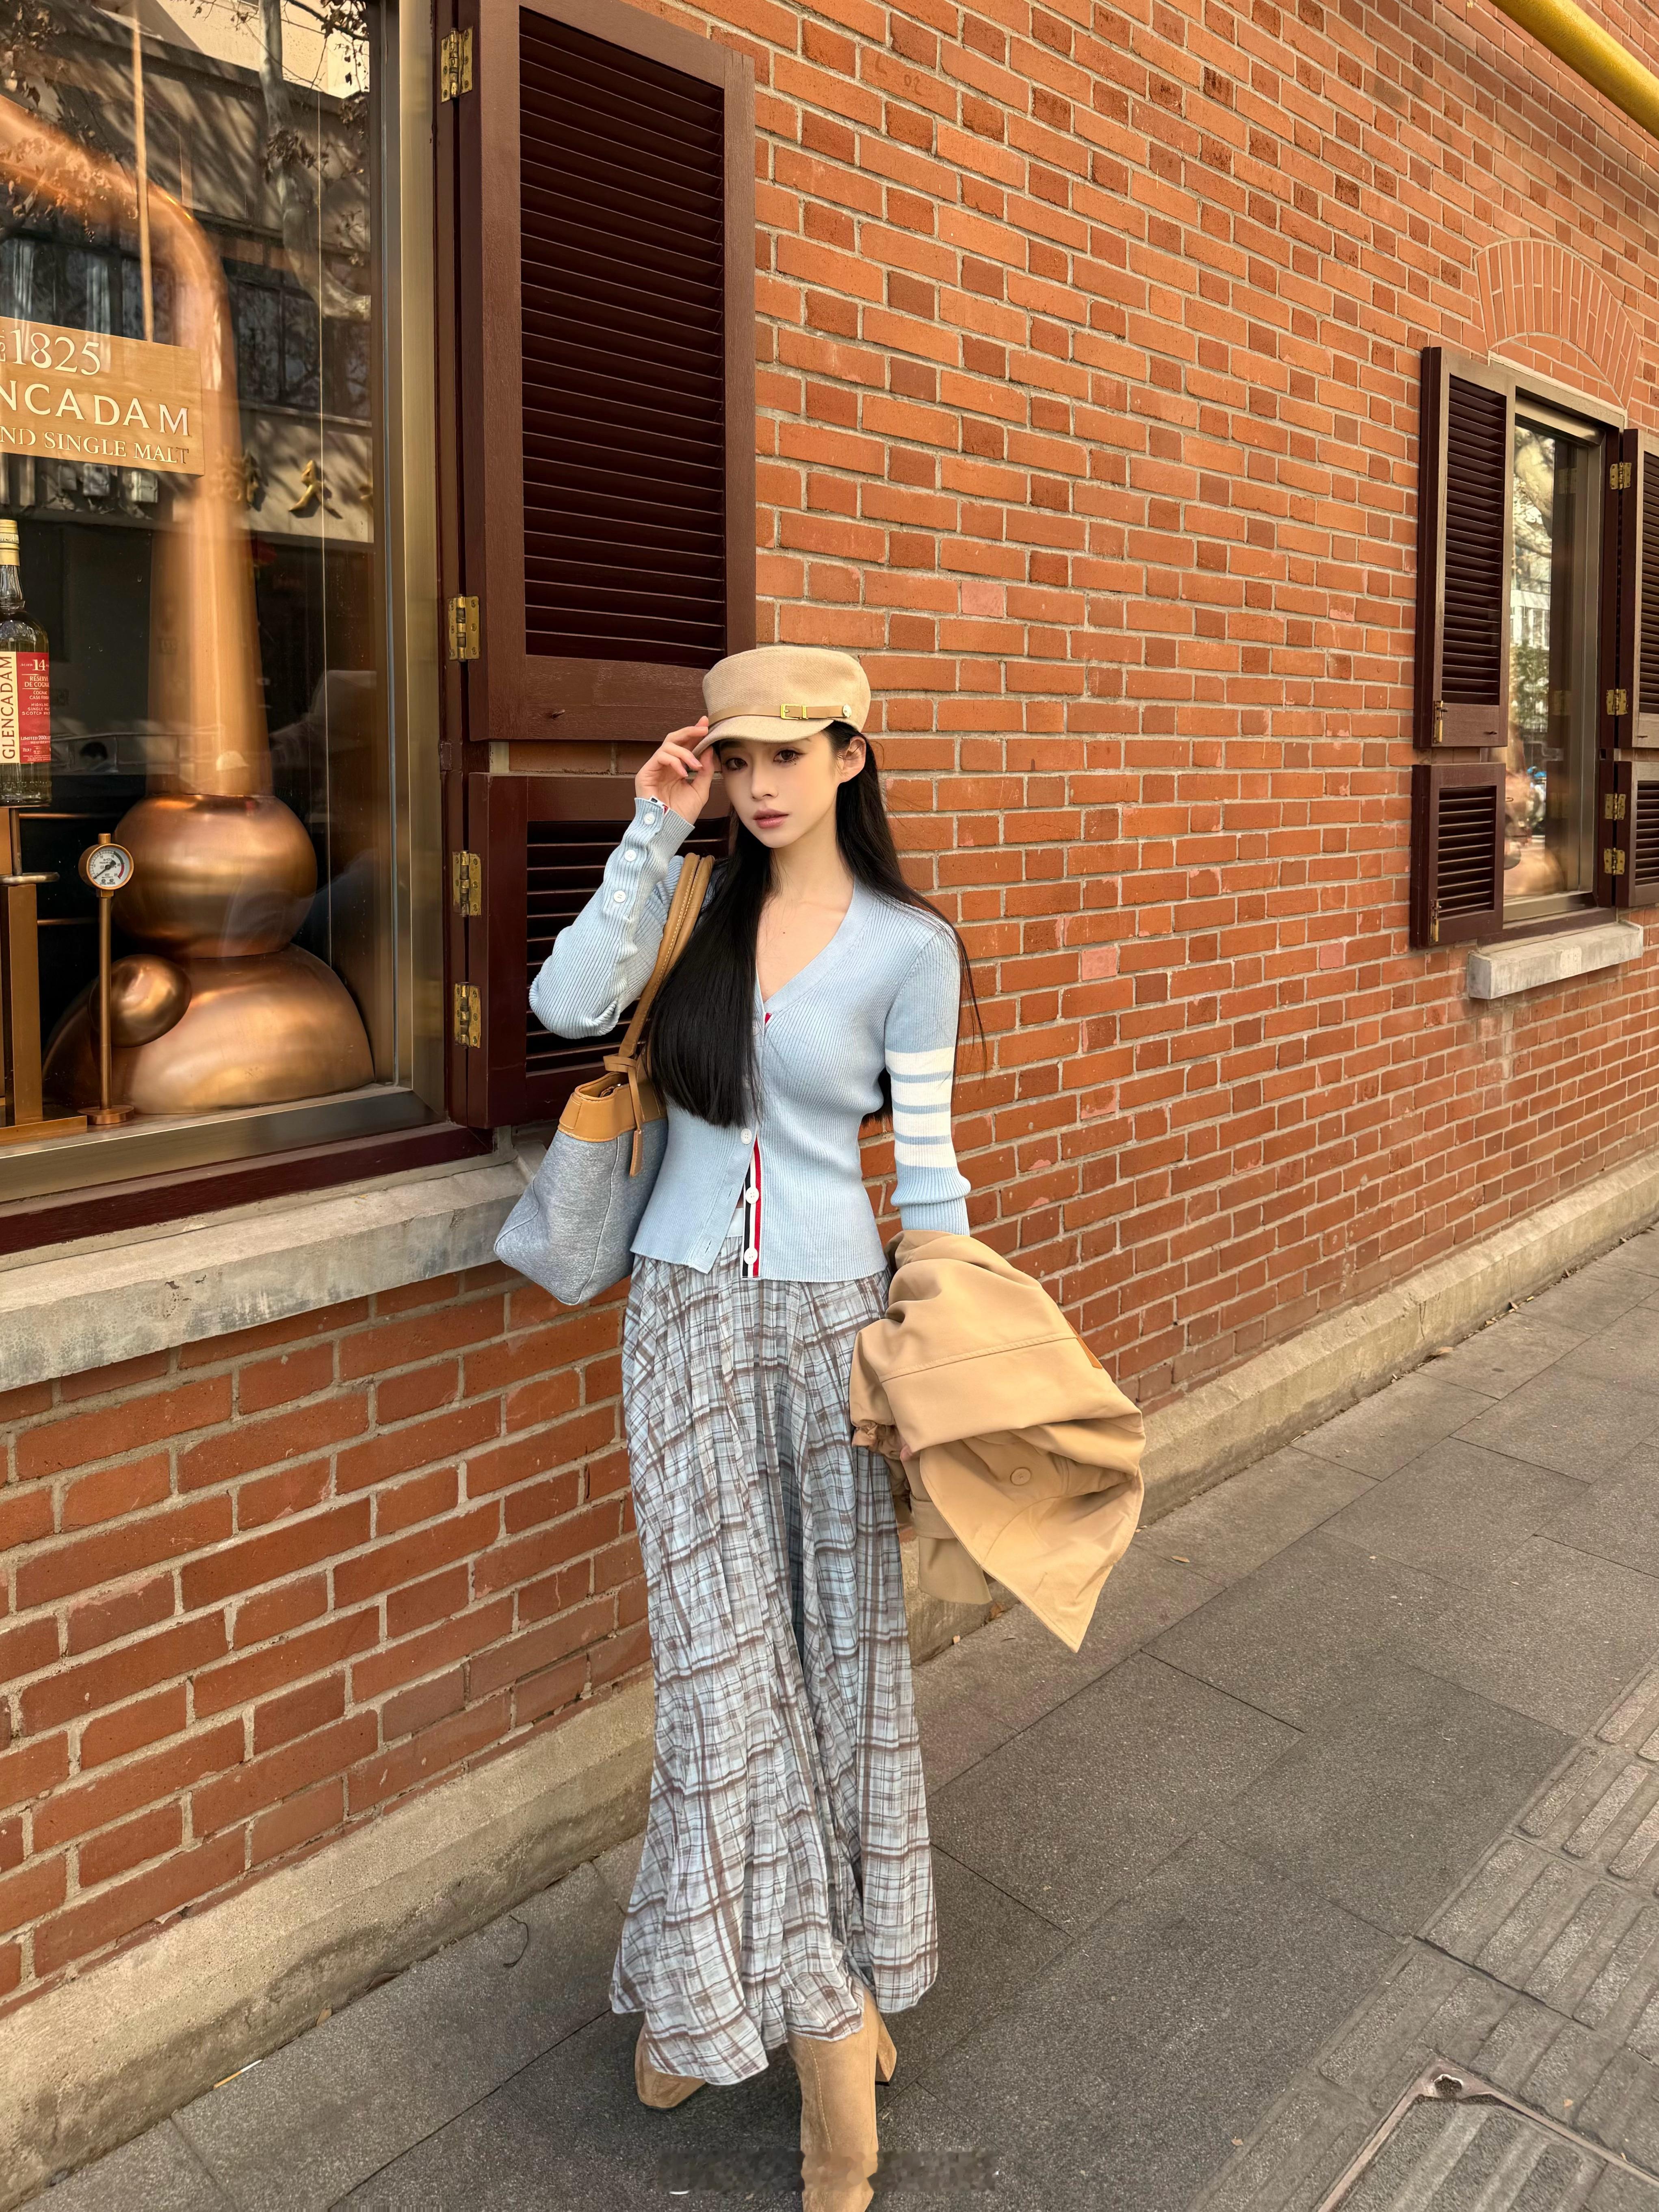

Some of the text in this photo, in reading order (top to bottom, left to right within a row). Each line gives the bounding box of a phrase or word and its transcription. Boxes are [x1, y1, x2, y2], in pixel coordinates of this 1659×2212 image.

[10, 329, 101, 375] 1825
[0, 426, 189, 464] ND SINGLE MALT
[32, 659, 46, 671] 14
[0, 656, 15, 759] GLENCADAM
